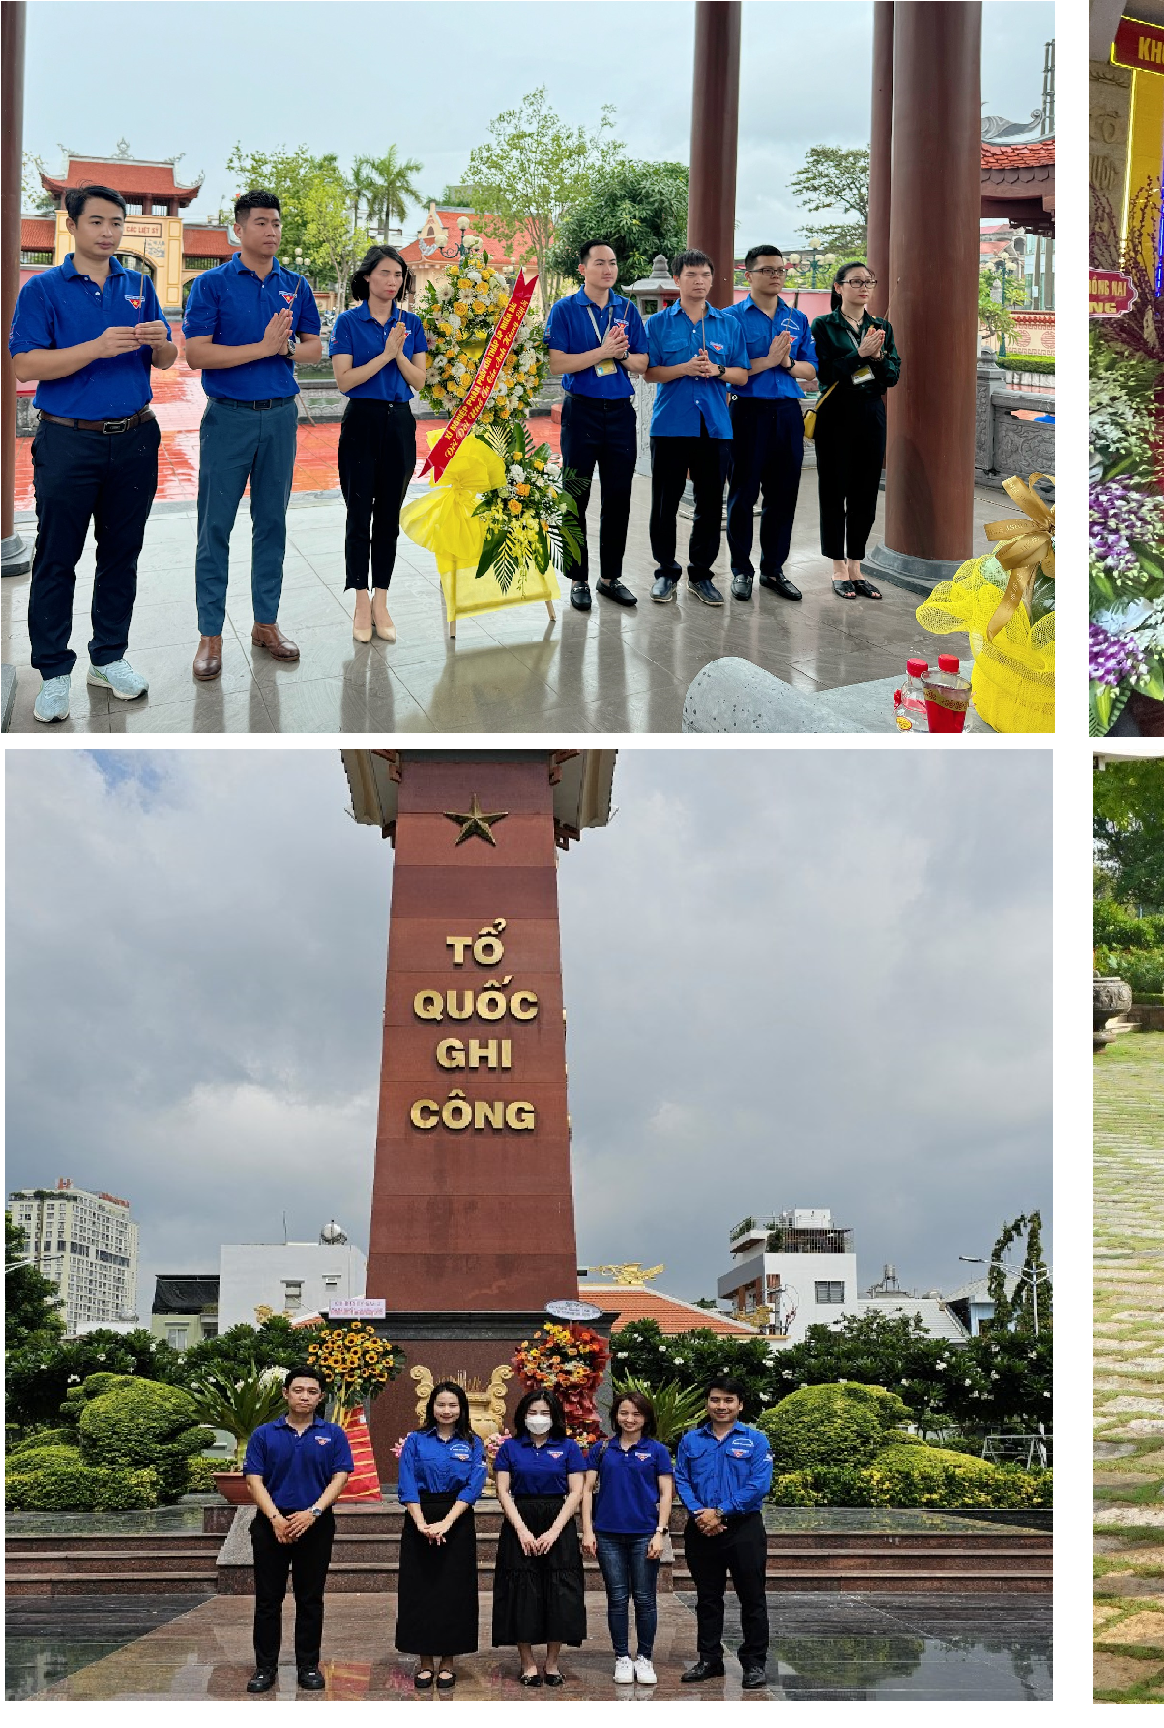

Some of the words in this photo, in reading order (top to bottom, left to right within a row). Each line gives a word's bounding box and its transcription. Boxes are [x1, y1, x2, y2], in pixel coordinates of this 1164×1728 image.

[1111, 280, 1127, 297] NAI
[446, 918, 507, 965] TỔ
[413, 975, 539, 1021] QUỐC
[436, 1037, 512, 1069] GHI
[410, 1088, 535, 1130] CÔNG
